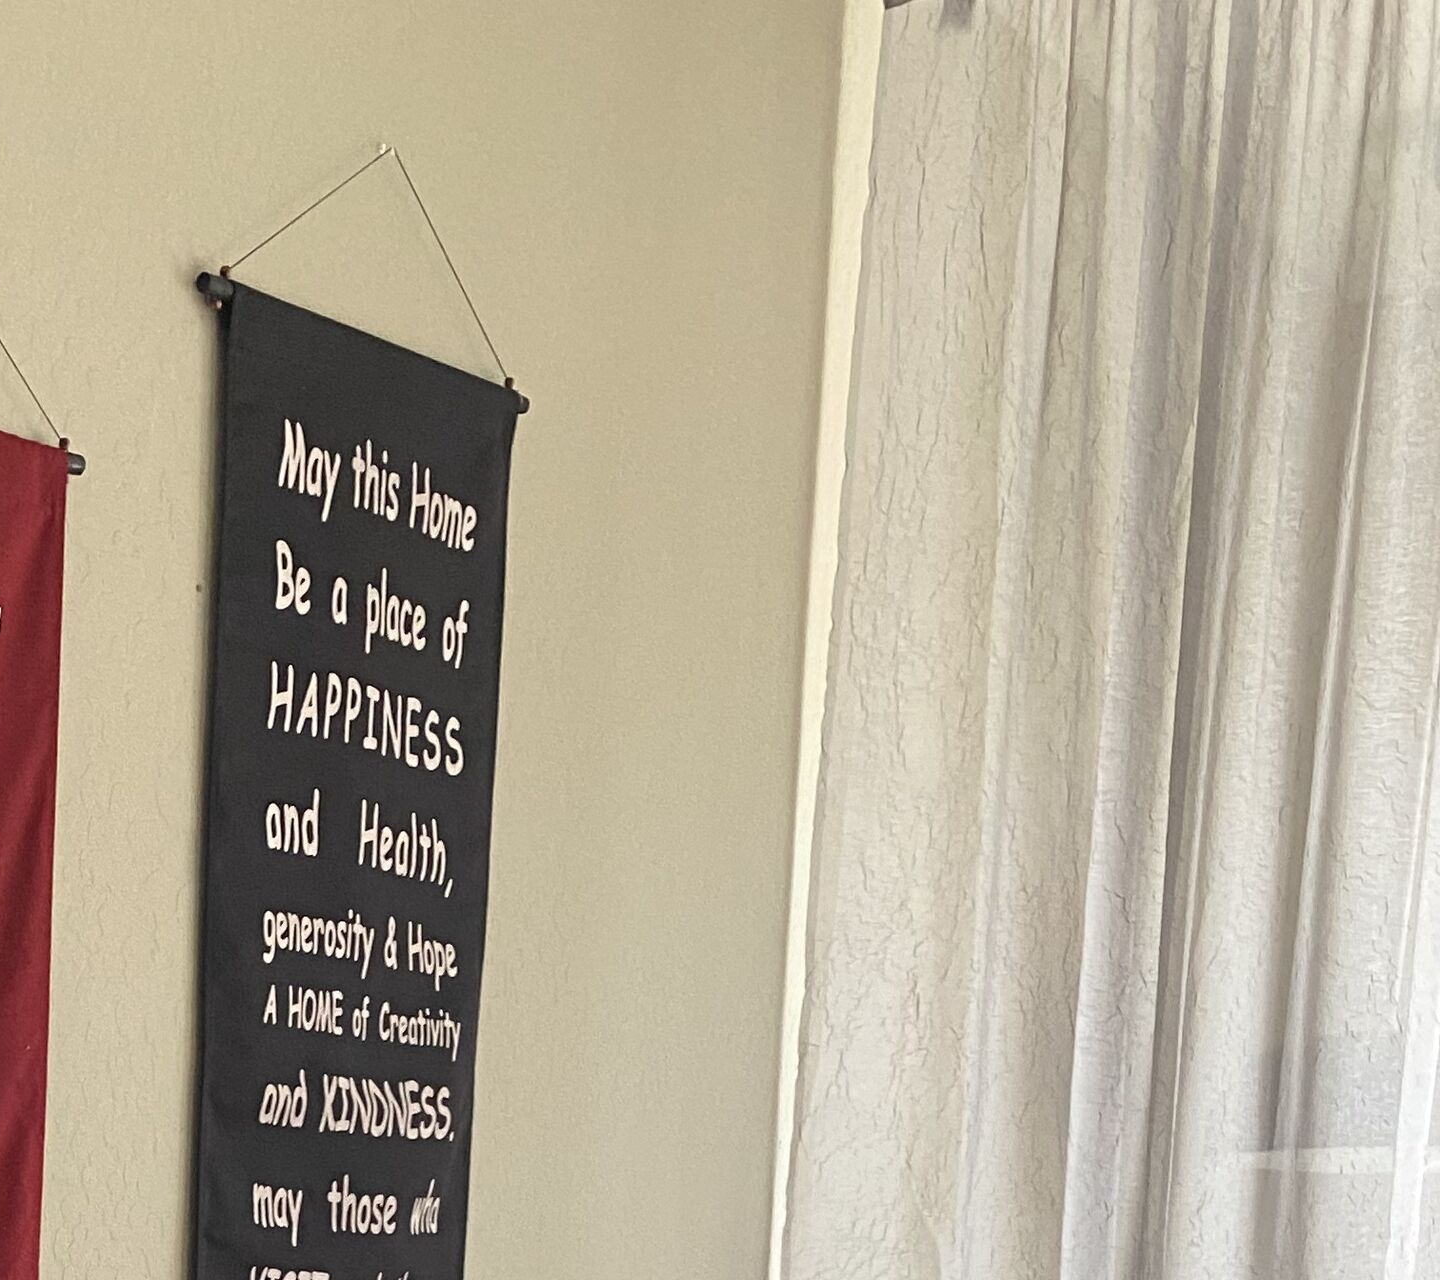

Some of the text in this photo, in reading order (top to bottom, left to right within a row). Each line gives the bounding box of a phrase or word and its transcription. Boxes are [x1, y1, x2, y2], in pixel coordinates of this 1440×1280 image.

[279, 419, 476, 551] May this Home
[276, 540, 469, 669] Be a place of
[268, 661, 463, 775] HAPPINESS
[266, 789, 452, 897] and Health,
[263, 909, 457, 991] generosity & Hope
[264, 985, 460, 1061] A HOME of Creativity
[260, 1069, 307, 1127] and
[253, 1175, 440, 1246] may those who
